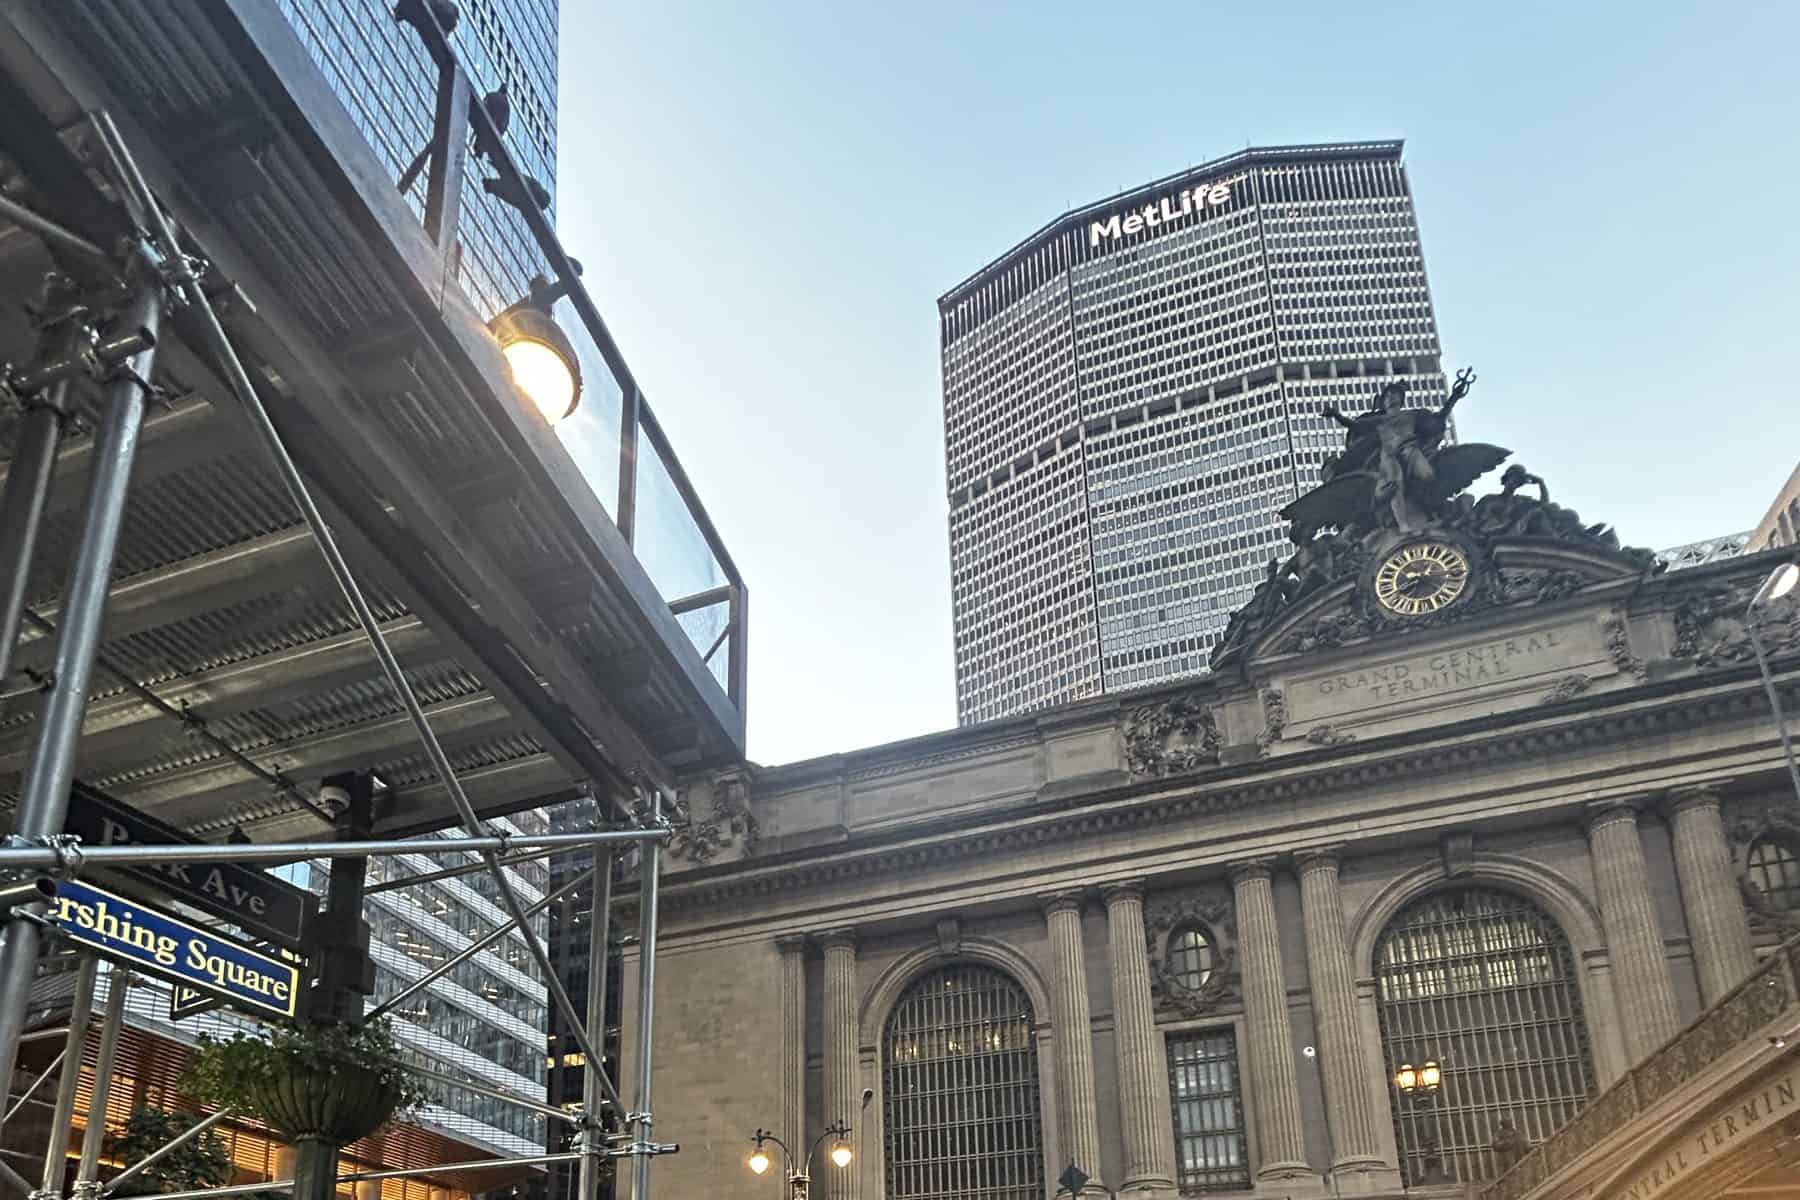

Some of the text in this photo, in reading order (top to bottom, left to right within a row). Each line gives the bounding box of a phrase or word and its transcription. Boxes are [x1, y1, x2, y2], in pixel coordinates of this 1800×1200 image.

[1089, 182, 1232, 248] MetLife
[1318, 632, 1562, 695] GRAND CENTRAL
[1371, 661, 1511, 700] TERMINAL
[99, 817, 266, 915] Pk Ave
[47, 895, 290, 1001] rshing Square
